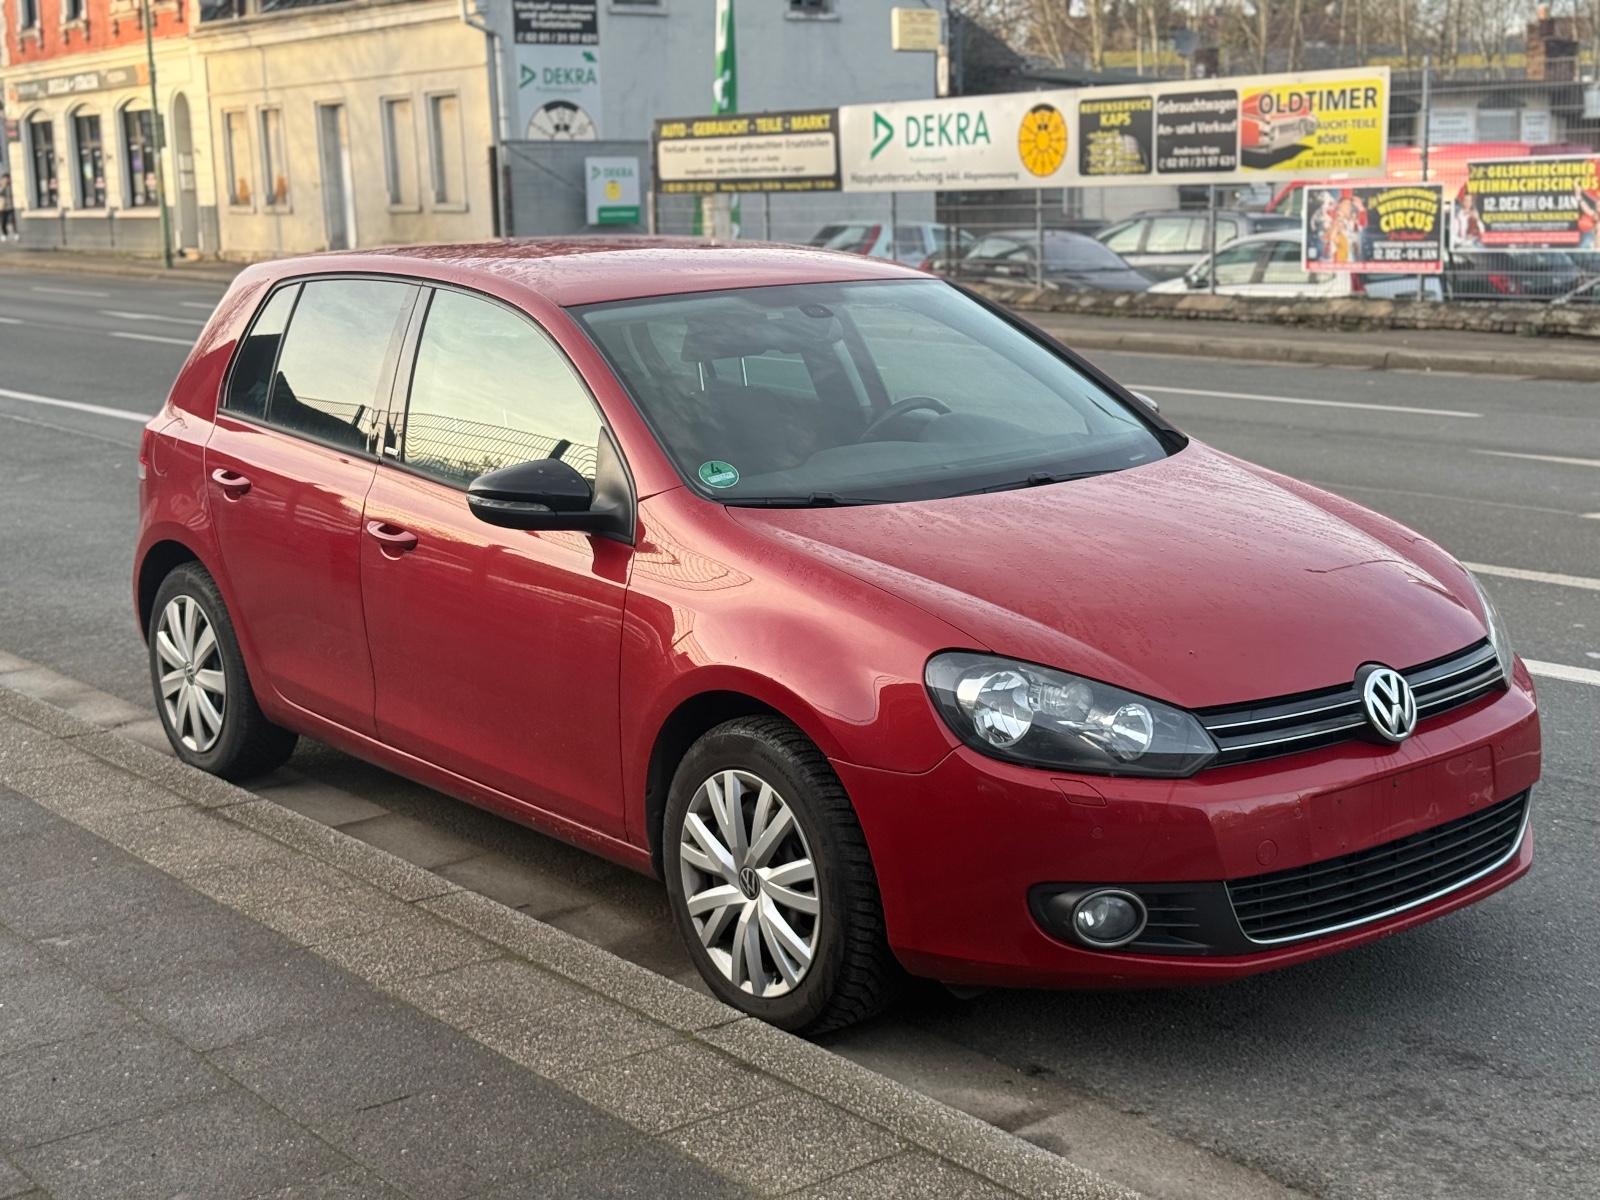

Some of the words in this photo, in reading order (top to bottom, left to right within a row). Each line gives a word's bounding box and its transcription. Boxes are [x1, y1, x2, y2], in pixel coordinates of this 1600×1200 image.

[543, 68, 597, 85] DEKRA
[1158, 97, 1237, 114] Gebrauchtwagen
[1259, 87, 1378, 114] OLDTIMER
[661, 123, 687, 137] AUTO
[693, 120, 748, 136] GEBRAUCHT
[756, 117, 783, 132] TEILE
[791, 114, 830, 131] MARKT
[1101, 112, 1131, 127] KAPS
[1176, 122, 1196, 135] und
[1197, 120, 1237, 134] Verkauf
[906, 111, 991, 148] DEKRA
[1317, 134, 1349, 145] BÖRSE
[1487, 163, 1597, 178] GELSENKIRCHENER
[1467, 177, 1598, 193] WEIHNACHTSCIRCUS
[1377, 198, 1438, 216] WEIHNACHTS
[1499, 196, 1520, 211] DEZ
[1557, 195, 1579, 211] JAN
[1380, 211, 1434, 232] CIRCUS
[710, 463, 722, 474] 4
